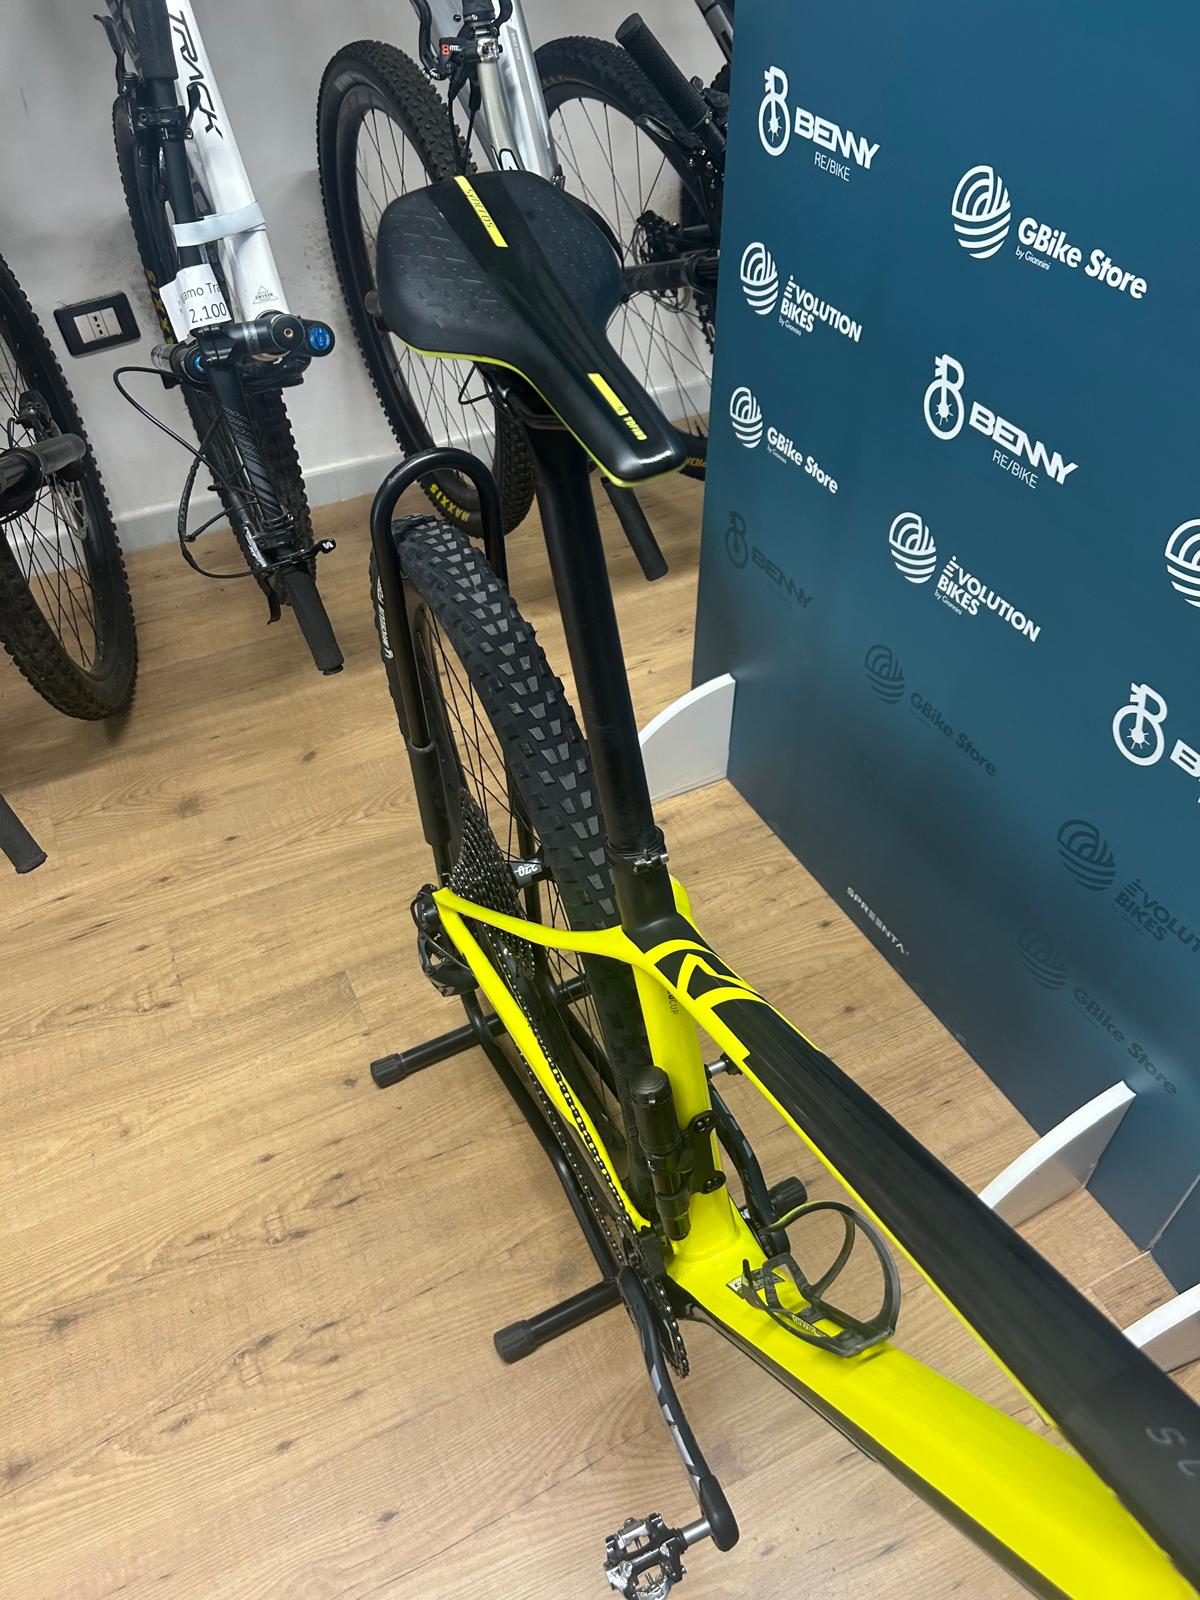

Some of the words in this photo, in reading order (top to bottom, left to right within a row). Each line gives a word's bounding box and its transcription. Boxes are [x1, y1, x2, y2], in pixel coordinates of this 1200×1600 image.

[794, 106, 881, 170] BENNY
[814, 151, 851, 182] RE/BIKE
[1015, 245, 1026, 260] by
[1018, 217, 1082, 268] GBike
[1084, 248, 1147, 299] Store
[189, 302, 228, 324] 2.100
[780, 297, 815, 333] BIKES
[767, 426, 803, 466] GBike
[804, 455, 838, 494] Store
[968, 401, 1079, 485] BENNY
[992, 449, 1038, 489] RE/BIKE
[751, 545, 813, 608] BENNY
[937, 574, 980, 616] BIKES
[910, 692, 953, 738] GBike
[955, 732, 996, 776] Store
[1115, 891, 1168, 941] BIKES
[1127, 1042, 1177, 1096] Store
